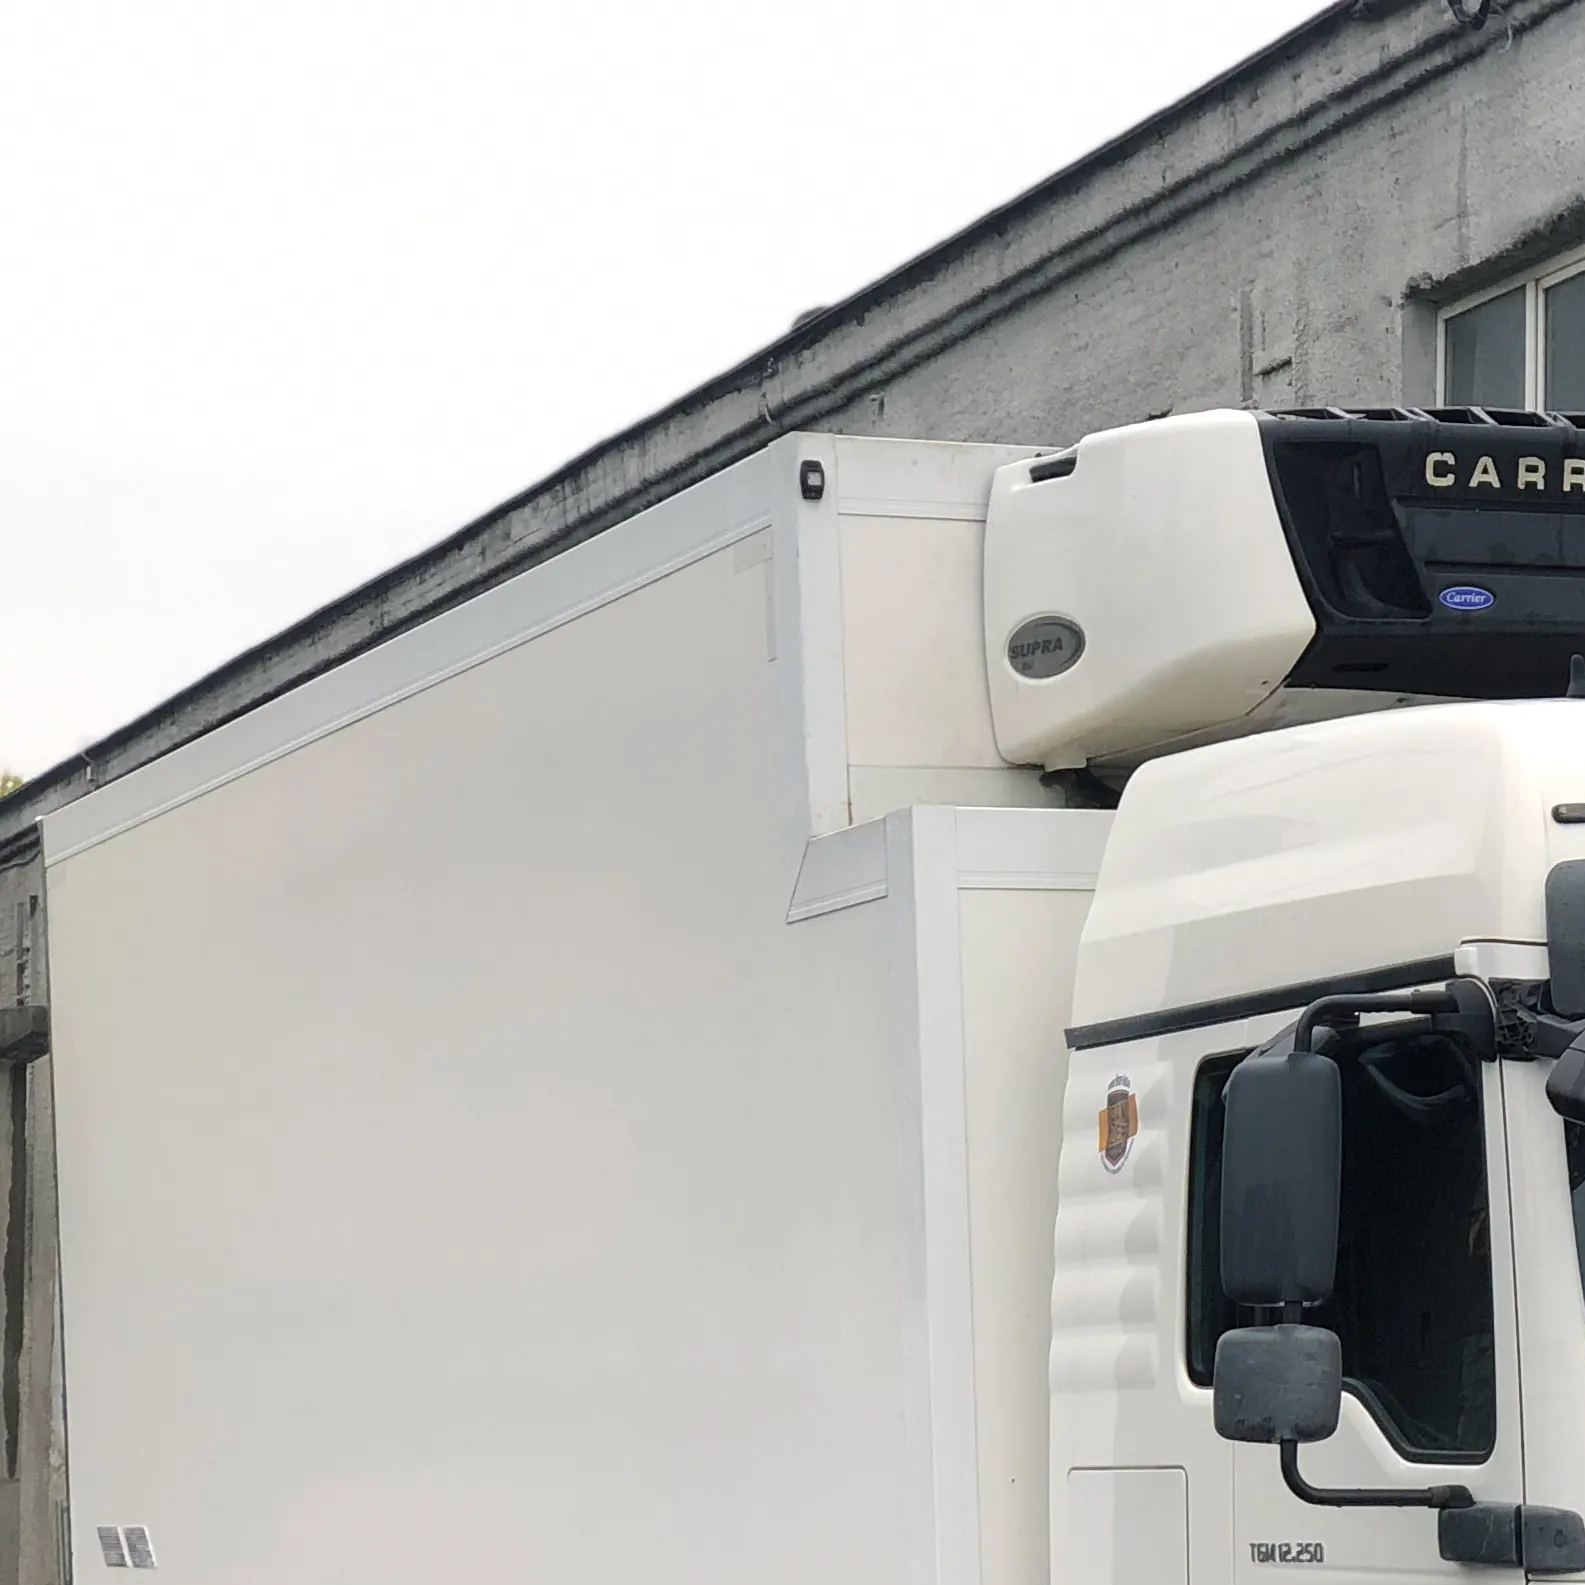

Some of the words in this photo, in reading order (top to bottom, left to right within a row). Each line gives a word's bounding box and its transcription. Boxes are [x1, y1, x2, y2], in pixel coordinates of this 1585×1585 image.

[1446, 591, 1486, 605] Carrier
[1010, 637, 1063, 660] SUPRA
[1278, 1543, 1324, 1563] 12.250
